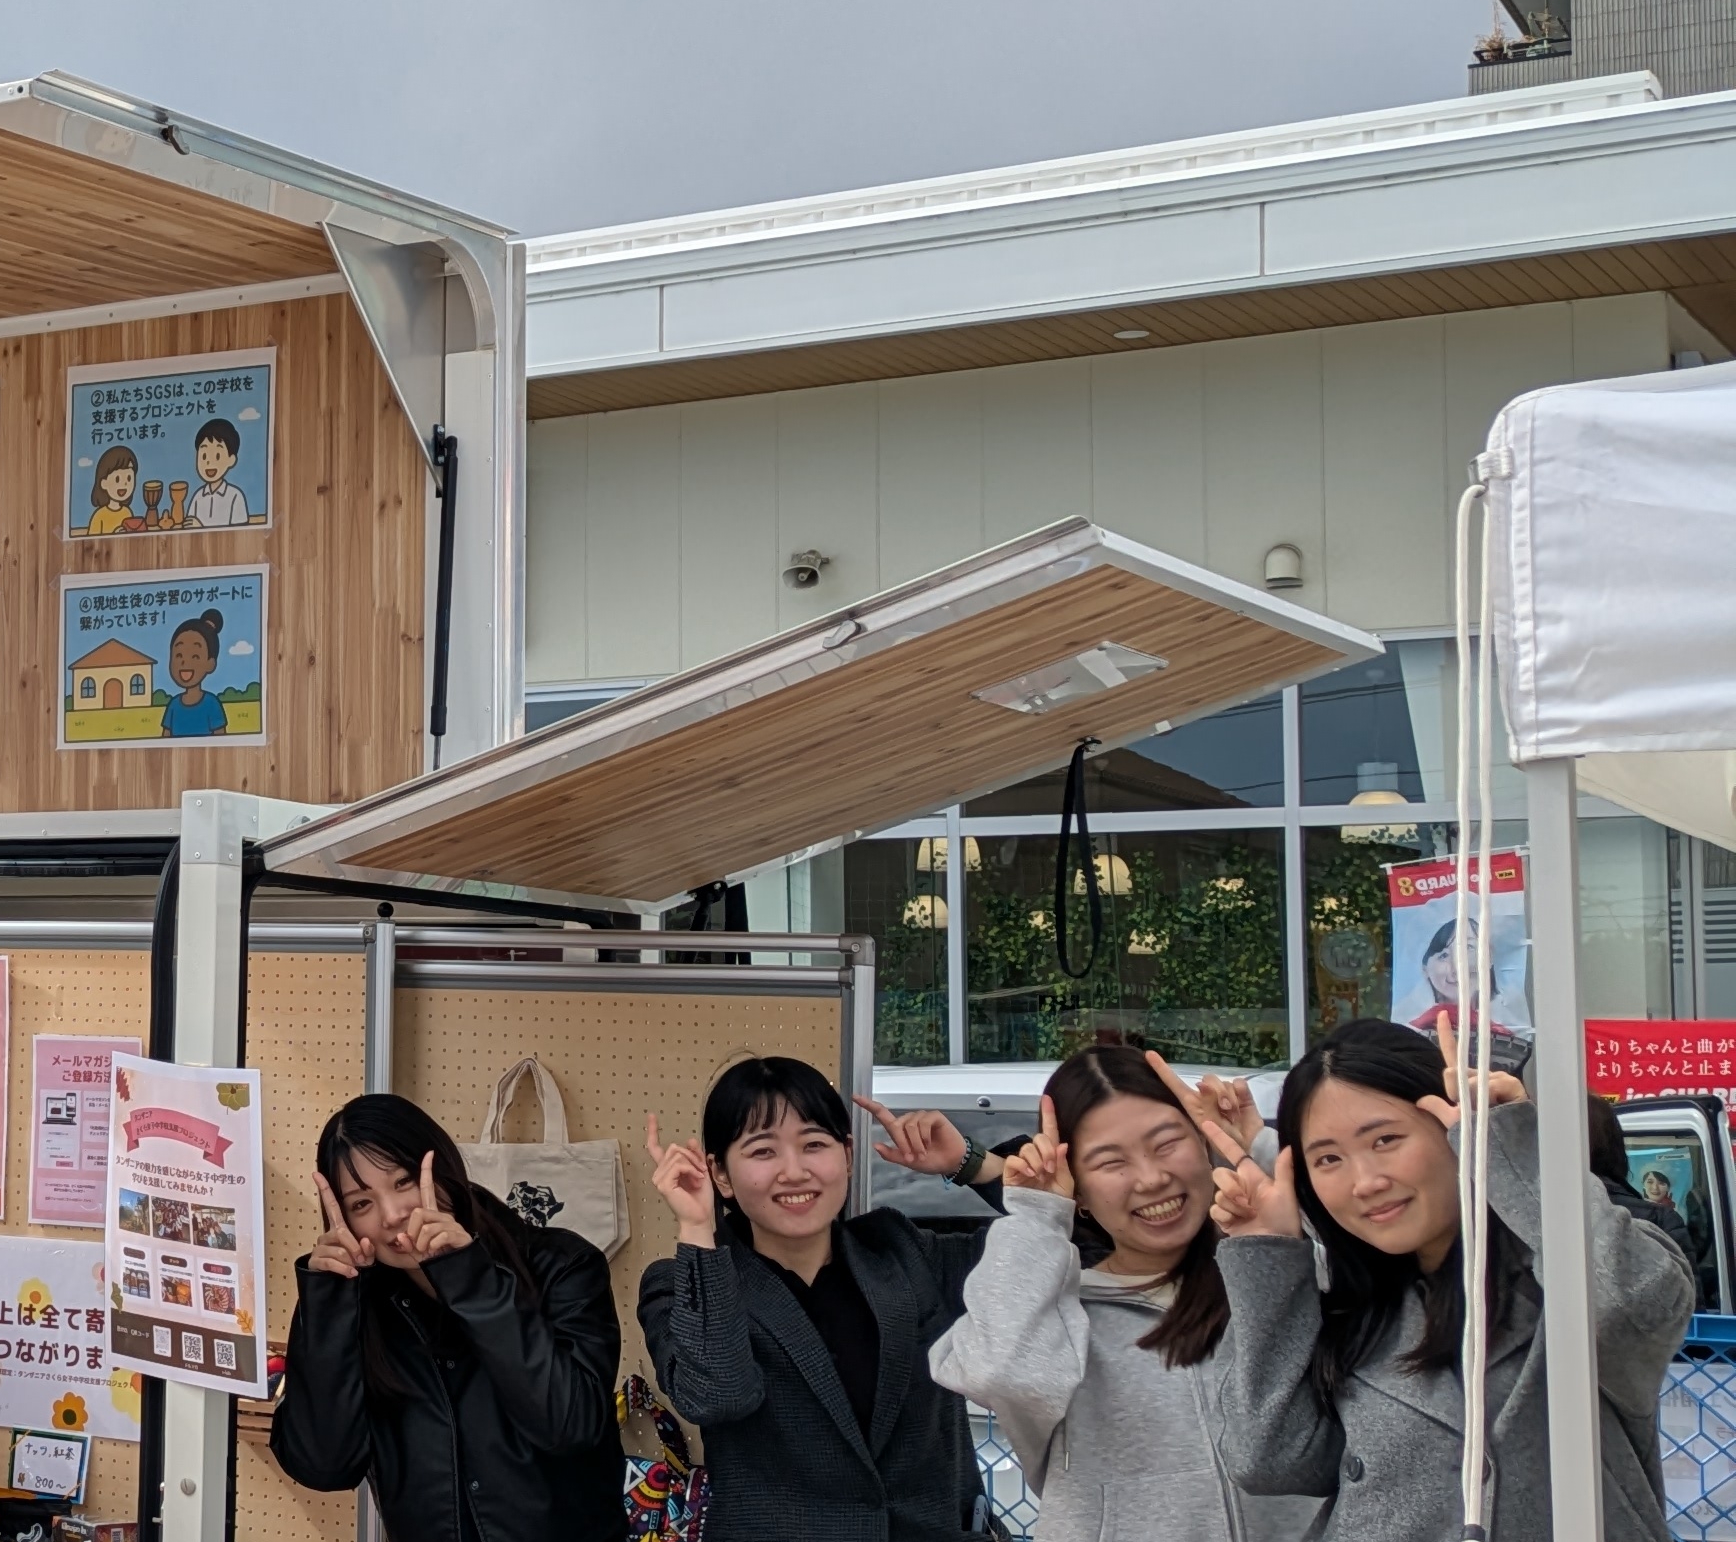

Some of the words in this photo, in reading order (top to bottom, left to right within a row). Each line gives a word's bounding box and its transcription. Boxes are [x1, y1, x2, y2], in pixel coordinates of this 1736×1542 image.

[91, 399, 216, 425] 支援するプロジェクトを
[91, 423, 165, 445] 行っています。
